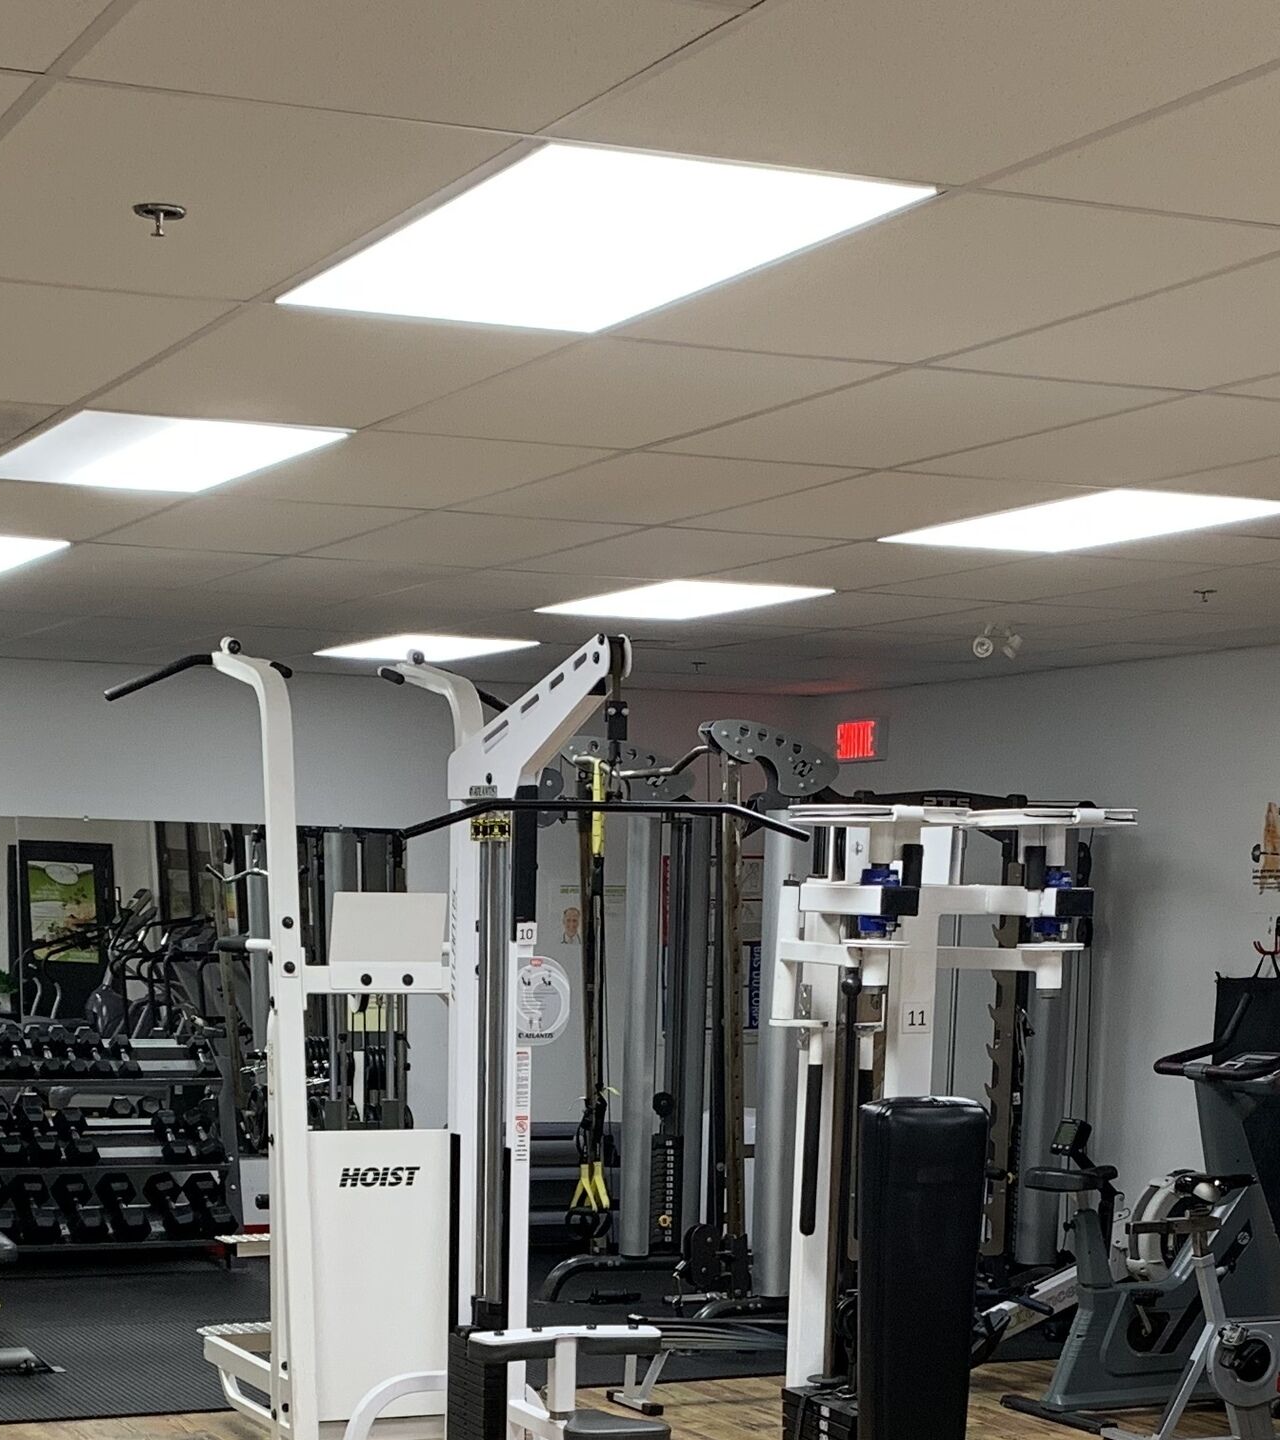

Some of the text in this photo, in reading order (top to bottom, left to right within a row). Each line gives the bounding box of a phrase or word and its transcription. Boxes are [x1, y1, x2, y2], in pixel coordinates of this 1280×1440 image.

[836, 720, 876, 760] SORTIE
[520, 928, 534, 940] 10
[908, 1010, 927, 1026] 11
[339, 1166, 421, 1187] HOIST
